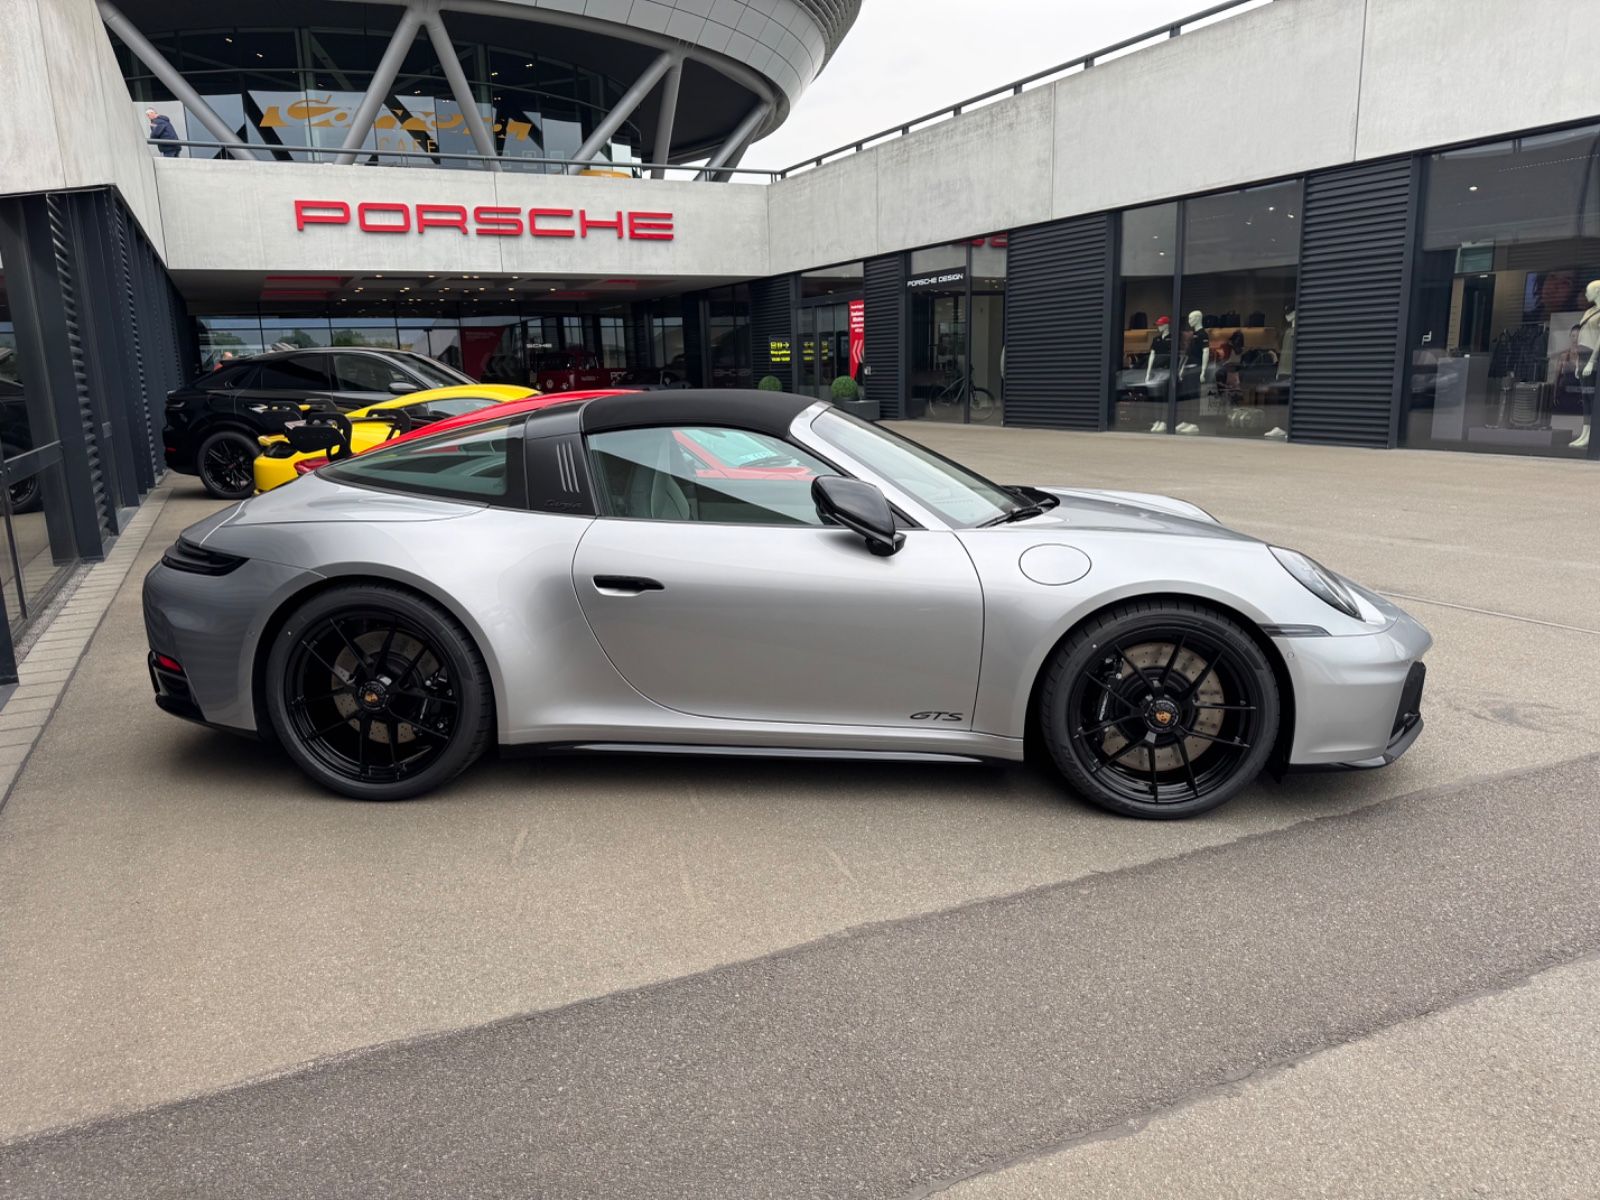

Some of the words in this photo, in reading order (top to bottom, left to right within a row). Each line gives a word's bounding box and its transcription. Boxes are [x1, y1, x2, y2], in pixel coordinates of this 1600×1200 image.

[295, 200, 674, 240] PORSCHE
[907, 278, 938, 287] PORSCHE
[938, 273, 964, 283] DESIGN
[910, 711, 963, 721] GTS
